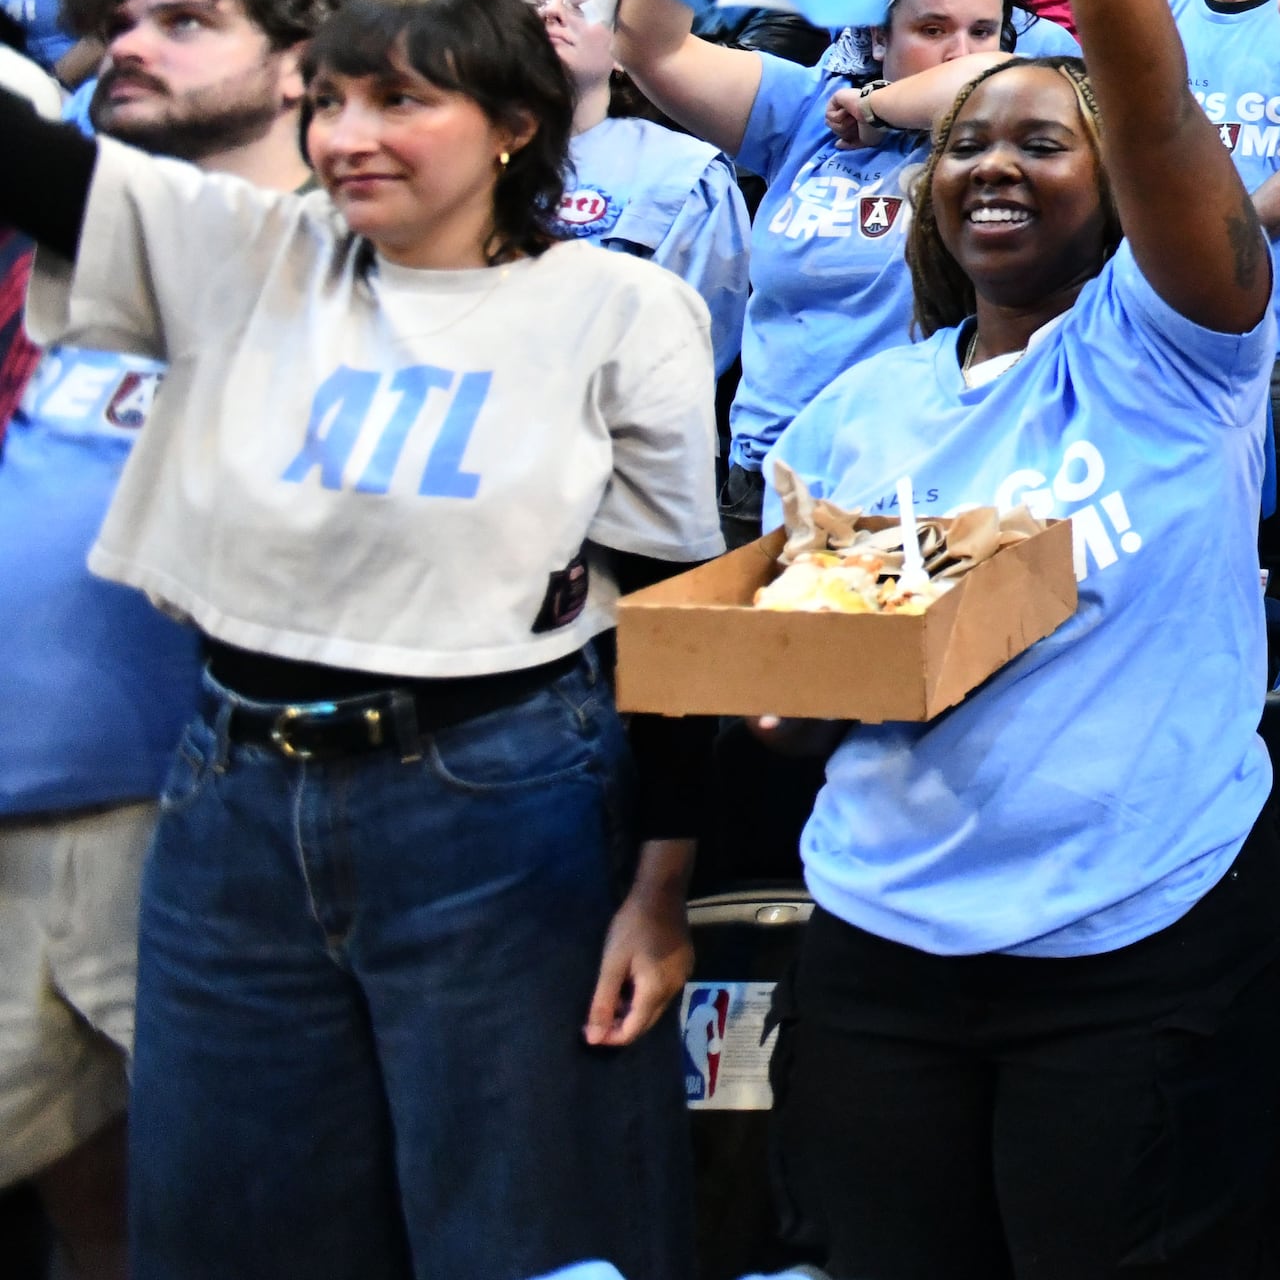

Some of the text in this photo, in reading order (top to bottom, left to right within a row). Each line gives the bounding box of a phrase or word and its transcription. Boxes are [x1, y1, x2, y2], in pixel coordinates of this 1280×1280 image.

[826, 160, 881, 181] FINALS
[280, 363, 494, 499] ATL
[994, 439, 1106, 519] GO
